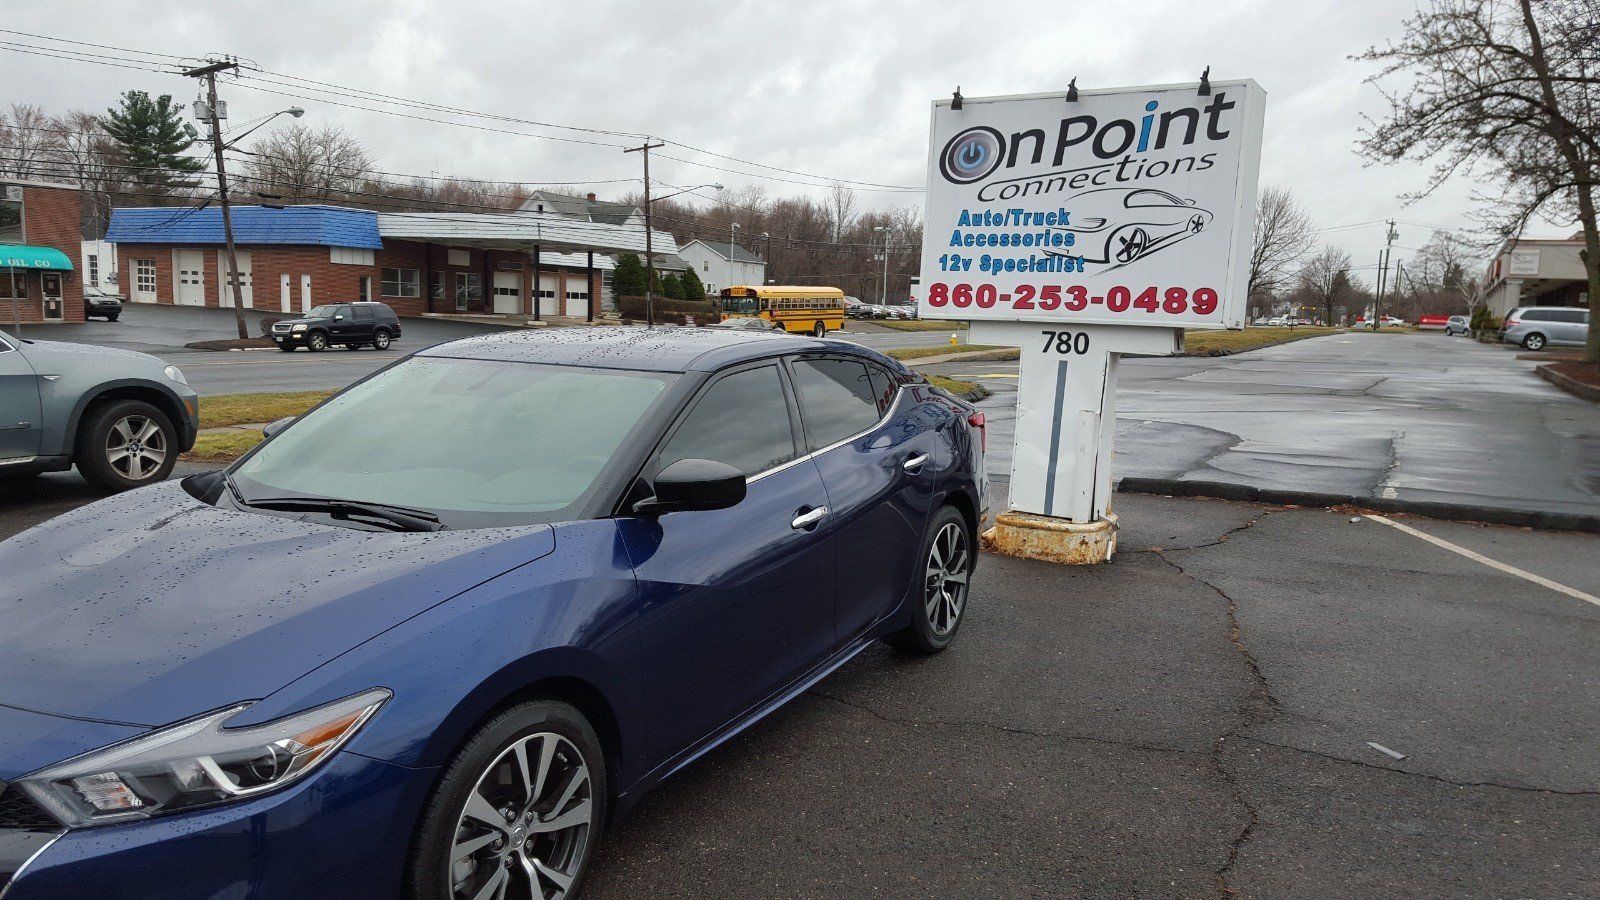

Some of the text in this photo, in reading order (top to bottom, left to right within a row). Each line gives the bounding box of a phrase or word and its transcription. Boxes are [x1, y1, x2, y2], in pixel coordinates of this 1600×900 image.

[977, 153, 1218, 202] Connections
[957, 207, 1071, 227] Auto/Truck
[949, 229, 1076, 247] Accessories
[939, 253, 1085, 275] 12v Specialist
[928, 283, 1218, 315] 860-253-0489
[1041, 331, 1090, 355] 780
